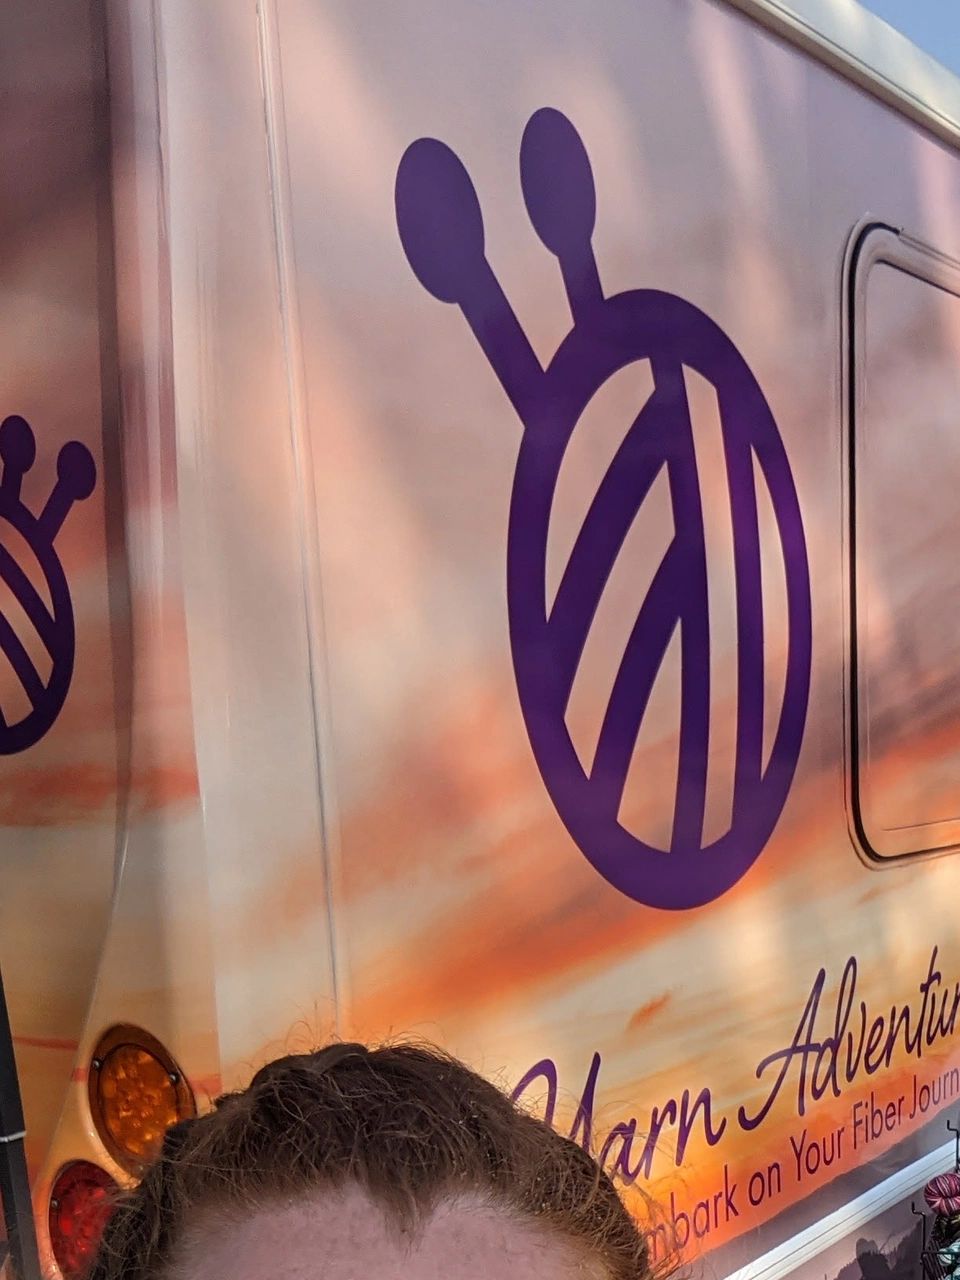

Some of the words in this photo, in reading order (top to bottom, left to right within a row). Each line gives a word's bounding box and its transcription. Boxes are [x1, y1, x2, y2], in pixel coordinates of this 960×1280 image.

[508, 1051, 728, 1187] Yarn
[643, 1163, 740, 1264] mbark
[748, 1160, 782, 1208] on
[789, 1127, 845, 1182] Your
[852, 1095, 905, 1151] Fiber
